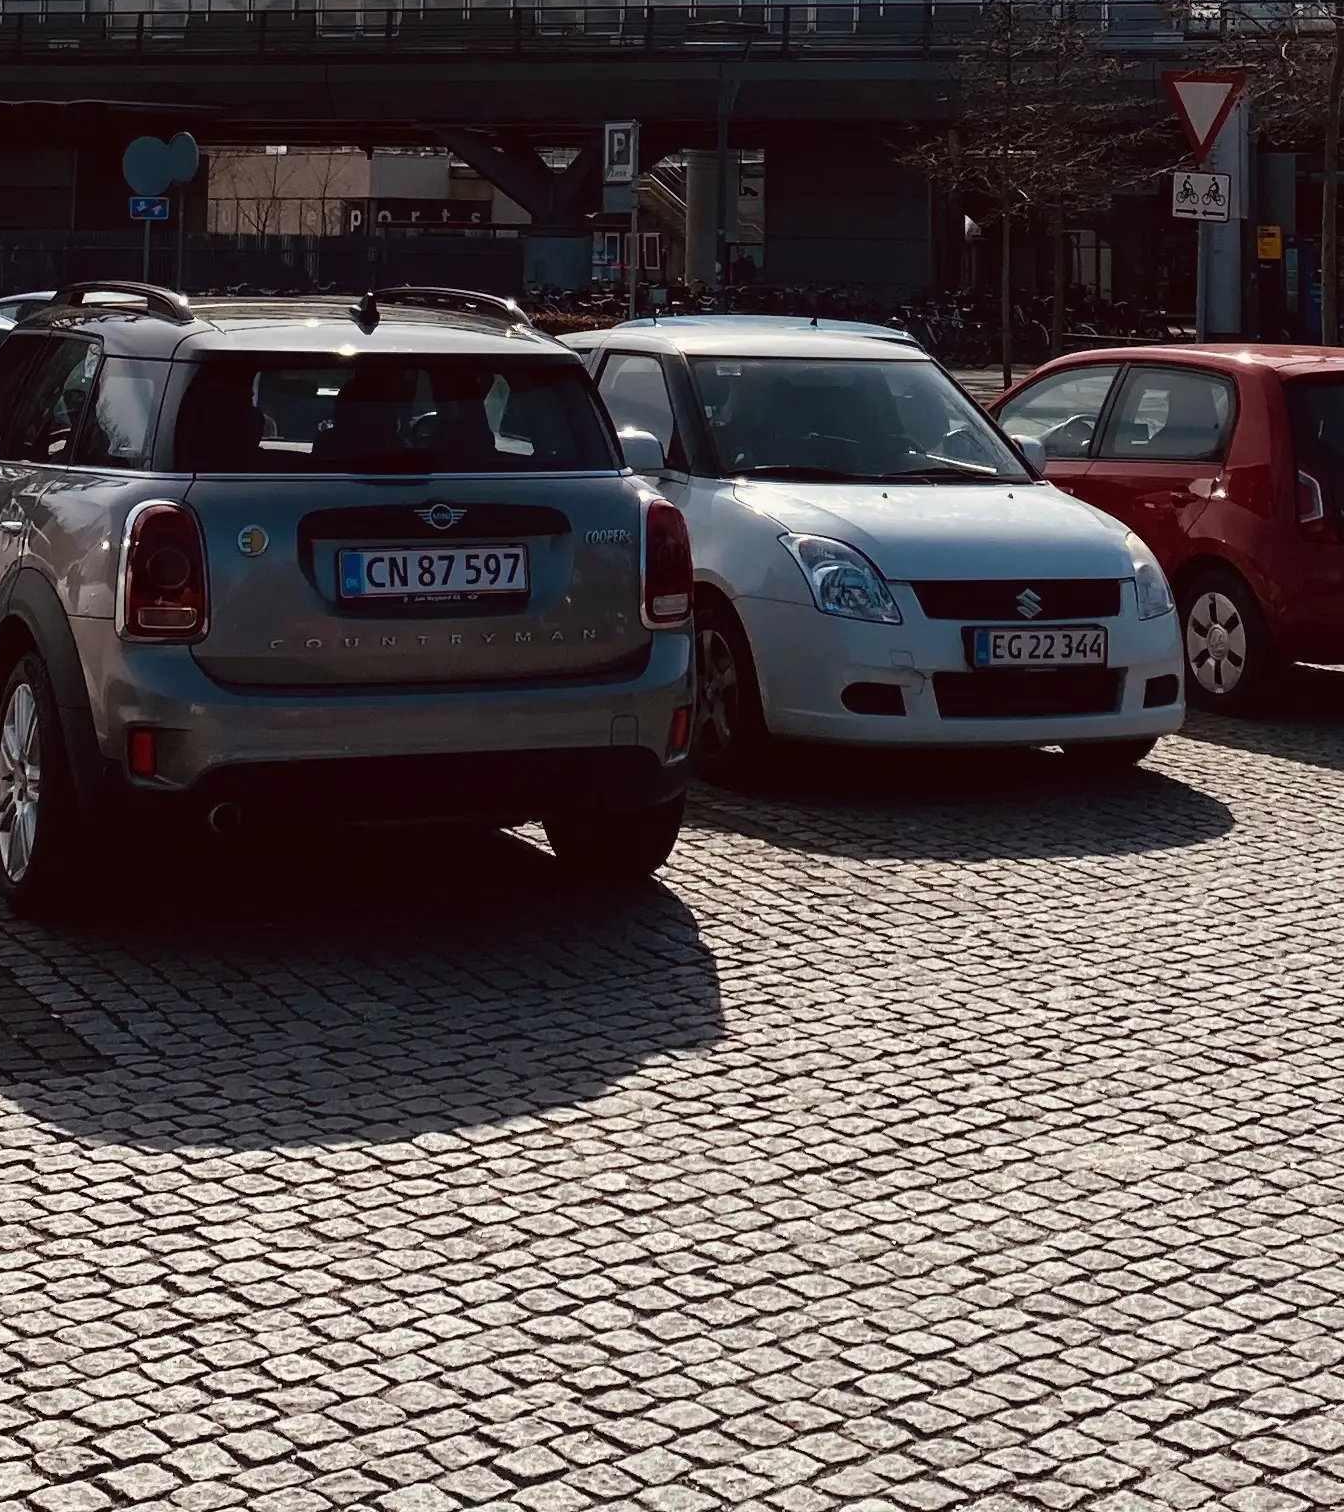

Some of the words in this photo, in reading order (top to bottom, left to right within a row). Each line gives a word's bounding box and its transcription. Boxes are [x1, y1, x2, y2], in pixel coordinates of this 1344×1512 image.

[613, 133, 625, 161] P
[366, 556, 408, 588] CN
[418, 555, 455, 587] 87
[465, 554, 521, 586] 597
[270, 629, 596, 649] COUNTRYMAN
[993, 635, 1022, 659] EG
[1028, 635, 1055, 659] 22
[1061, 634, 1102, 659] 344
